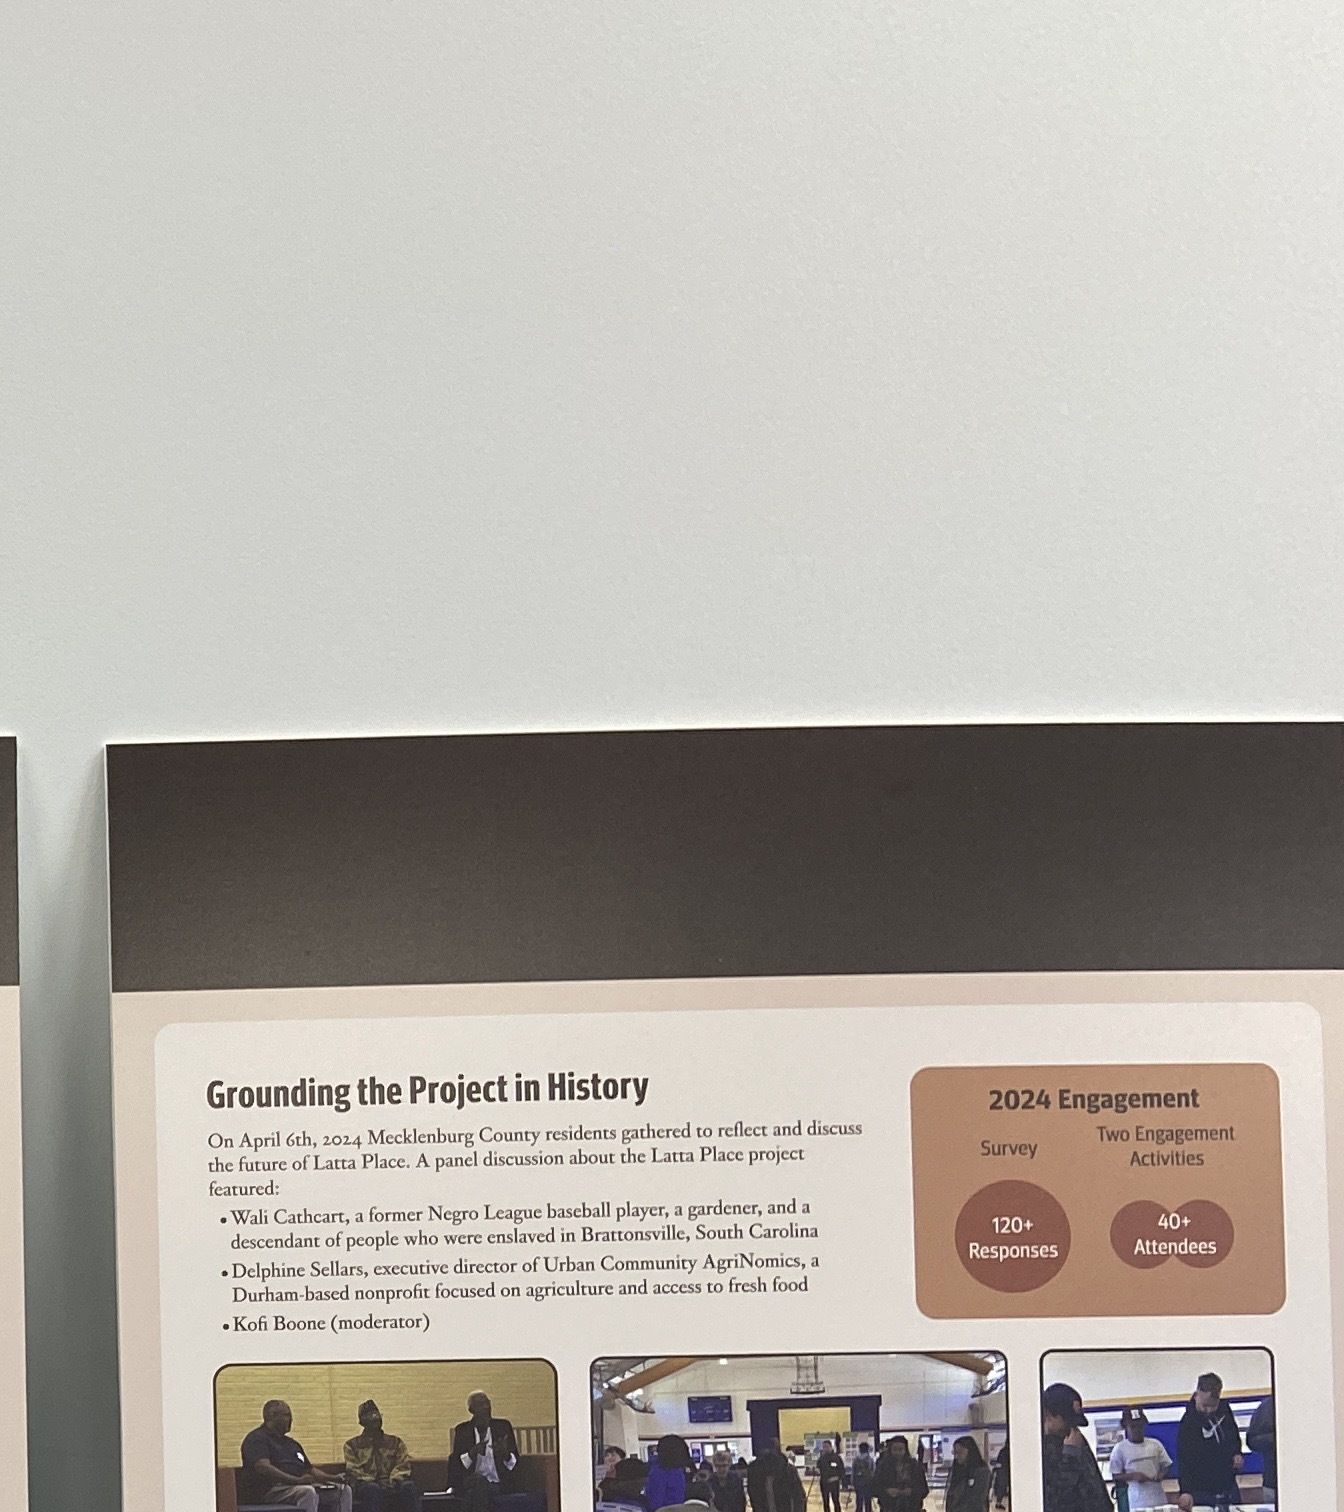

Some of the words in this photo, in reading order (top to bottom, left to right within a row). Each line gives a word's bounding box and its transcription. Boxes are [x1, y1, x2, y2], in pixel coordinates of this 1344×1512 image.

[205, 1076, 351, 1113] Grounding
[355, 1074, 402, 1106] the
[408, 1072, 508, 1110] Project
[514, 1071, 540, 1102] in
[547, 1070, 649, 1107] History
[988, 1087, 1052, 1111] 2024
[1057, 1087, 1200, 1114] Engagement
[1095, 1124, 1130, 1143] Two
[1134, 1124, 1235, 1146] Engagement
[979, 1138, 1038, 1160] Survey
[1128, 1149, 1205, 1167] Activities
[991, 1215, 1034, 1234] 120+
[1157, 1211, 1191, 1230] 40+
[968, 1241, 1059, 1263] Responses
[1133, 1236, 1217, 1255] Attendees
[232, 1314, 268, 1332] Kofi
[272, 1314, 326, 1331] Boone
[329, 1311, 430, 1335] (moderator)
